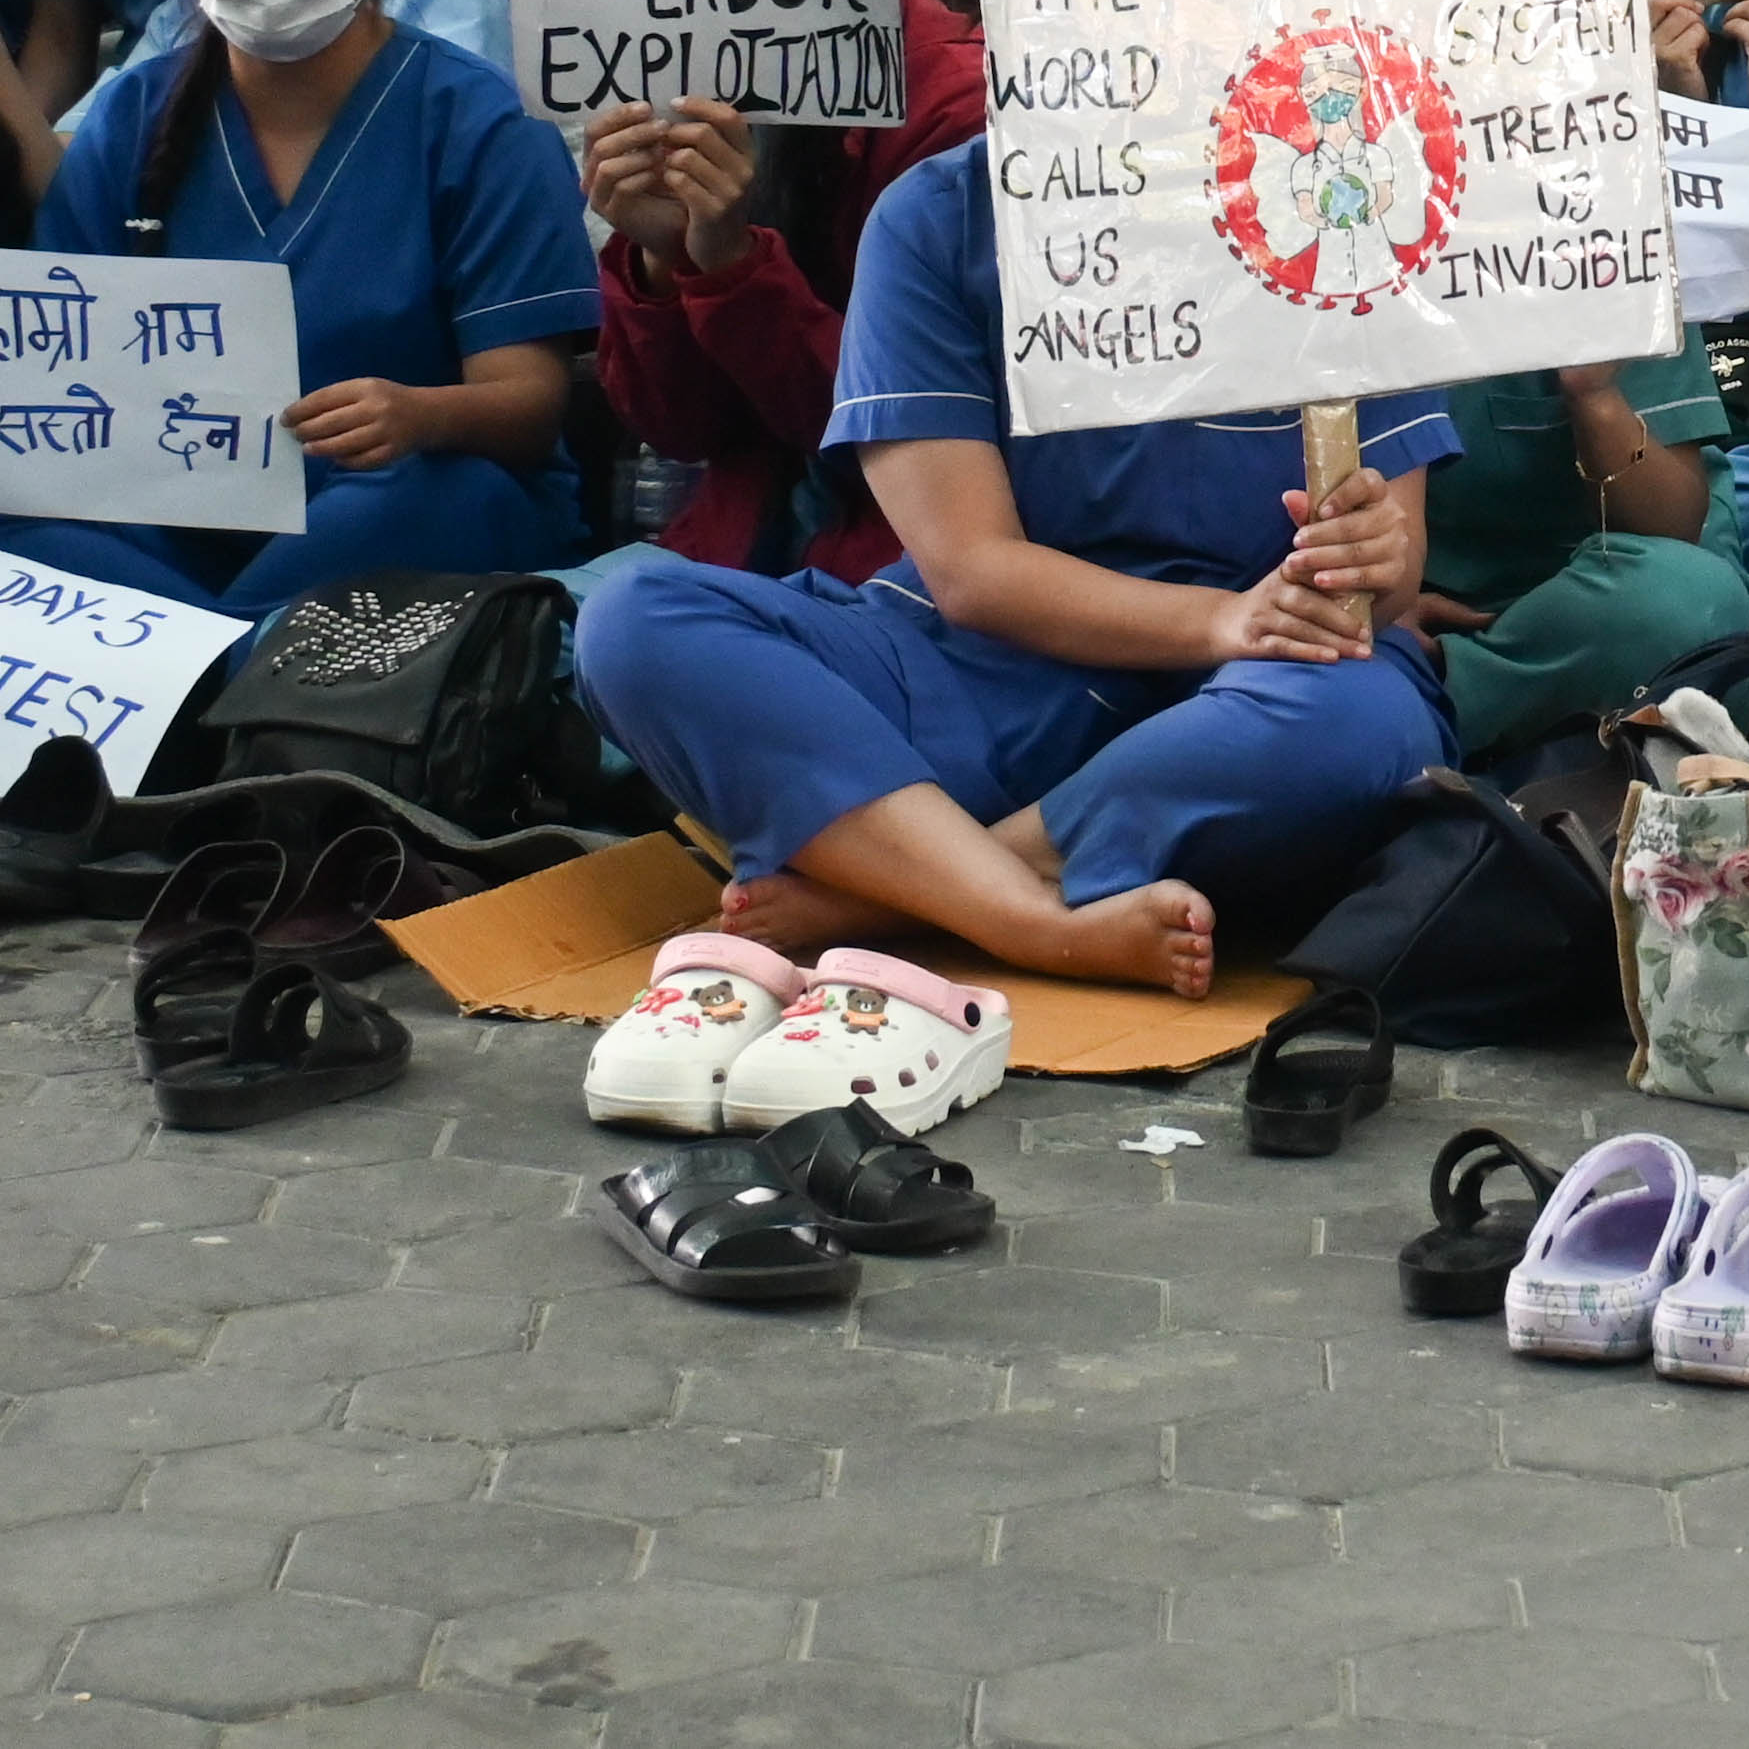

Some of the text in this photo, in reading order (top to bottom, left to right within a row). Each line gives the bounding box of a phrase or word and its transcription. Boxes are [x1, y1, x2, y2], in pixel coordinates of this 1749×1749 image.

[542, 18, 907, 120] EXPLOITATION
[986, 46, 1160, 114] WORLD
[1470, 92, 1638, 164] TREATS
[1001, 142, 1147, 202] CALLS
[1535, 179, 1594, 224] US
[1044, 228, 1121, 288] US
[1438, 228, 1663, 302] INVISIBLE
[1013, 300, 1203, 372] ANGELS
